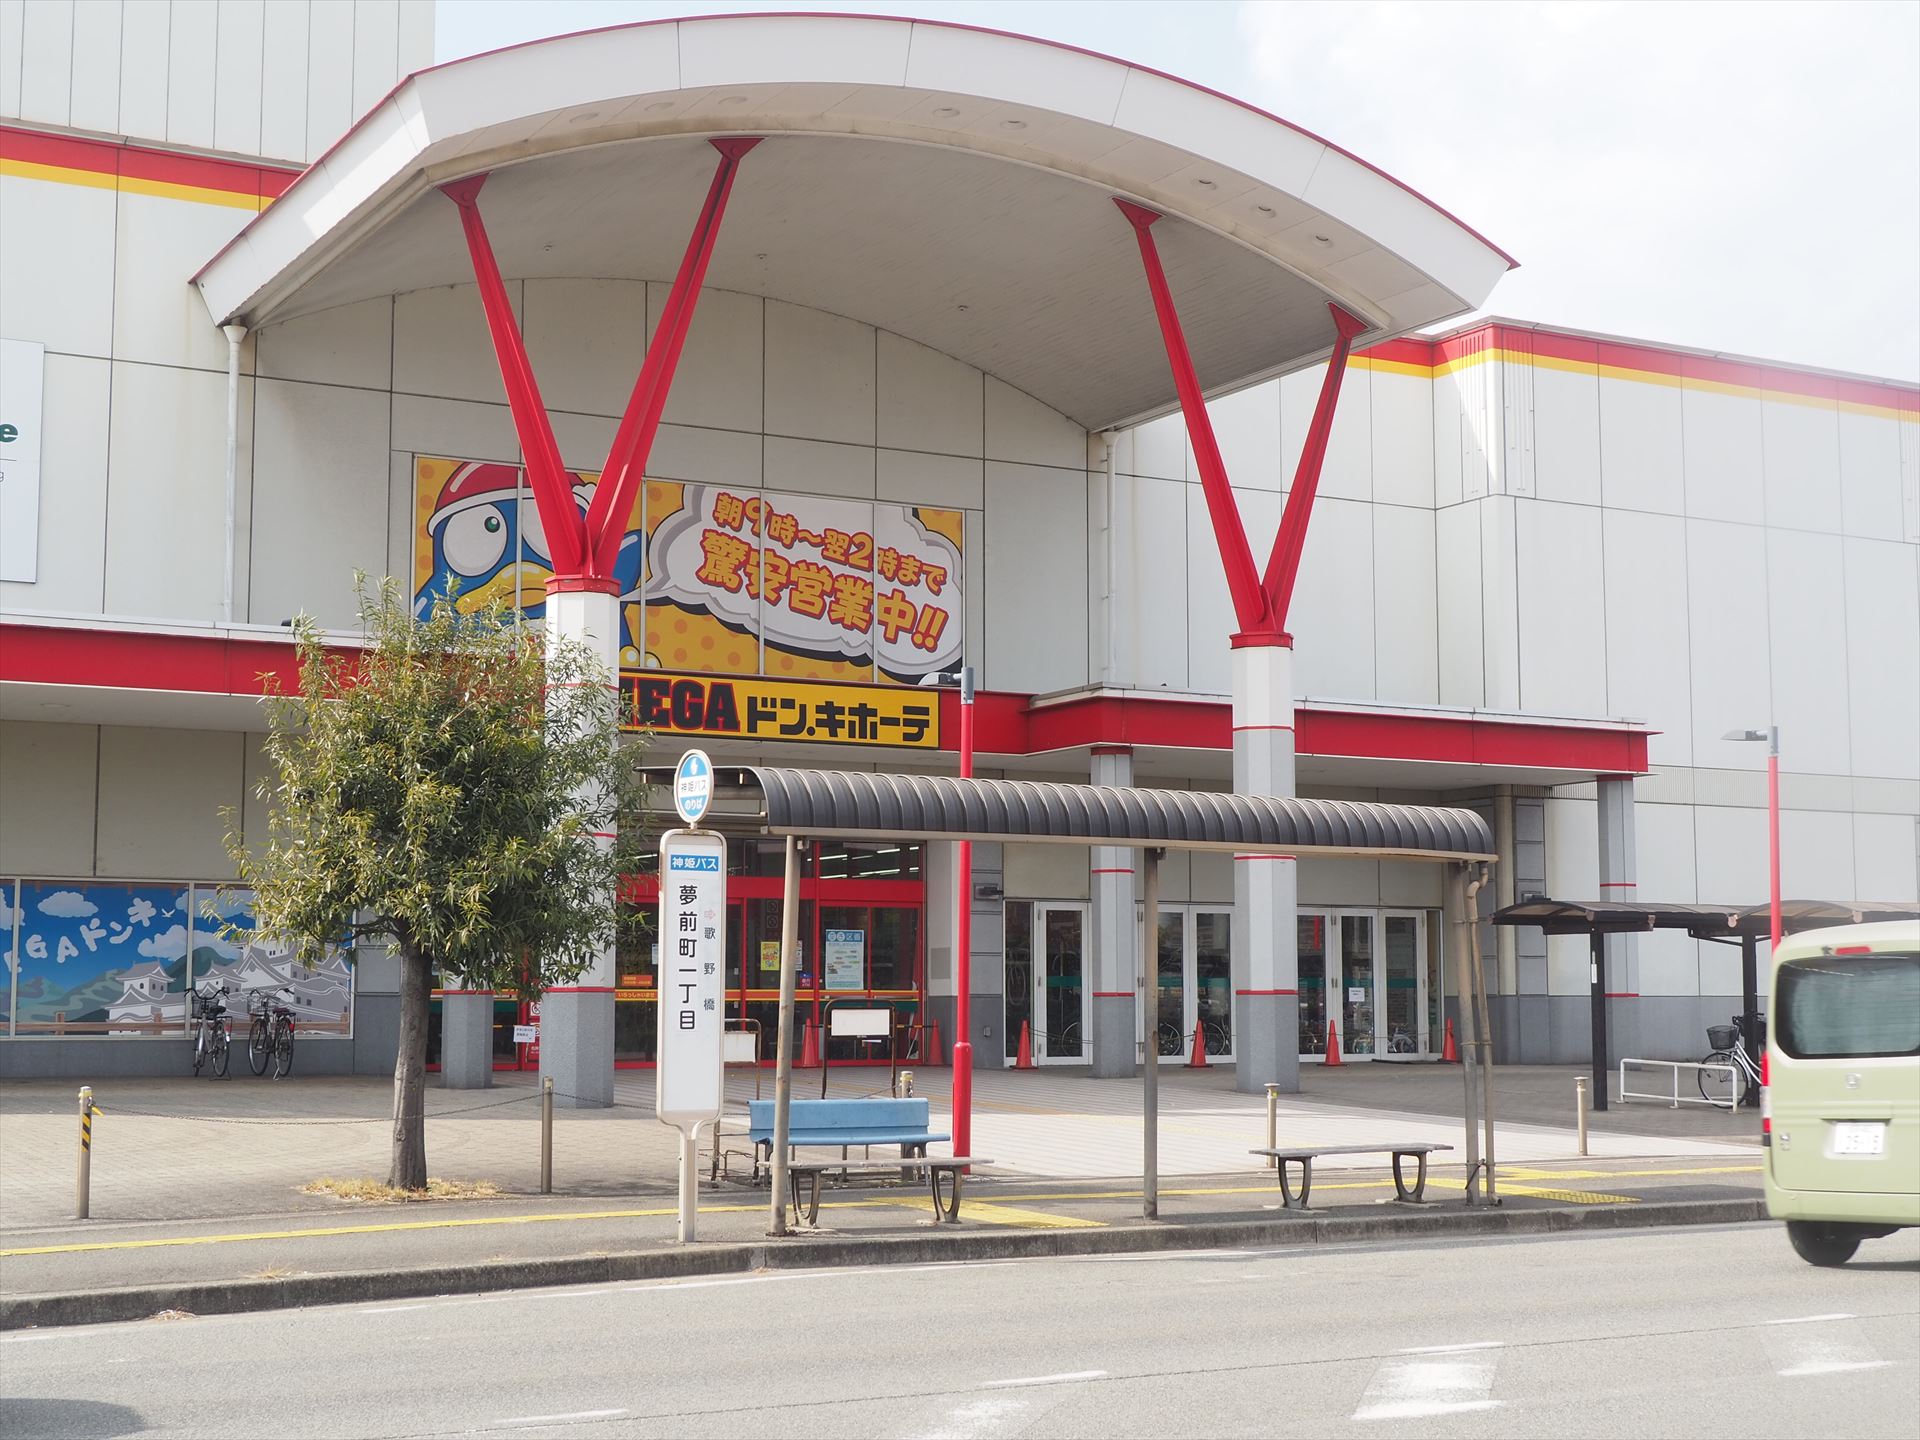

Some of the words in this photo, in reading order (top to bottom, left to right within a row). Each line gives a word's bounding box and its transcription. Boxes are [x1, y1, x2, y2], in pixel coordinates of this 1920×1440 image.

[696, 529, 948, 652] 驚安営業中!!
[681, 780, 706, 792] 神姫バス
[684, 800, 703, 811] のりば
[672, 857, 718, 870] 神姫バス
[678, 884, 698, 1030] 夢前町一丁目
[703, 926, 716, 1011] 歌野橋
